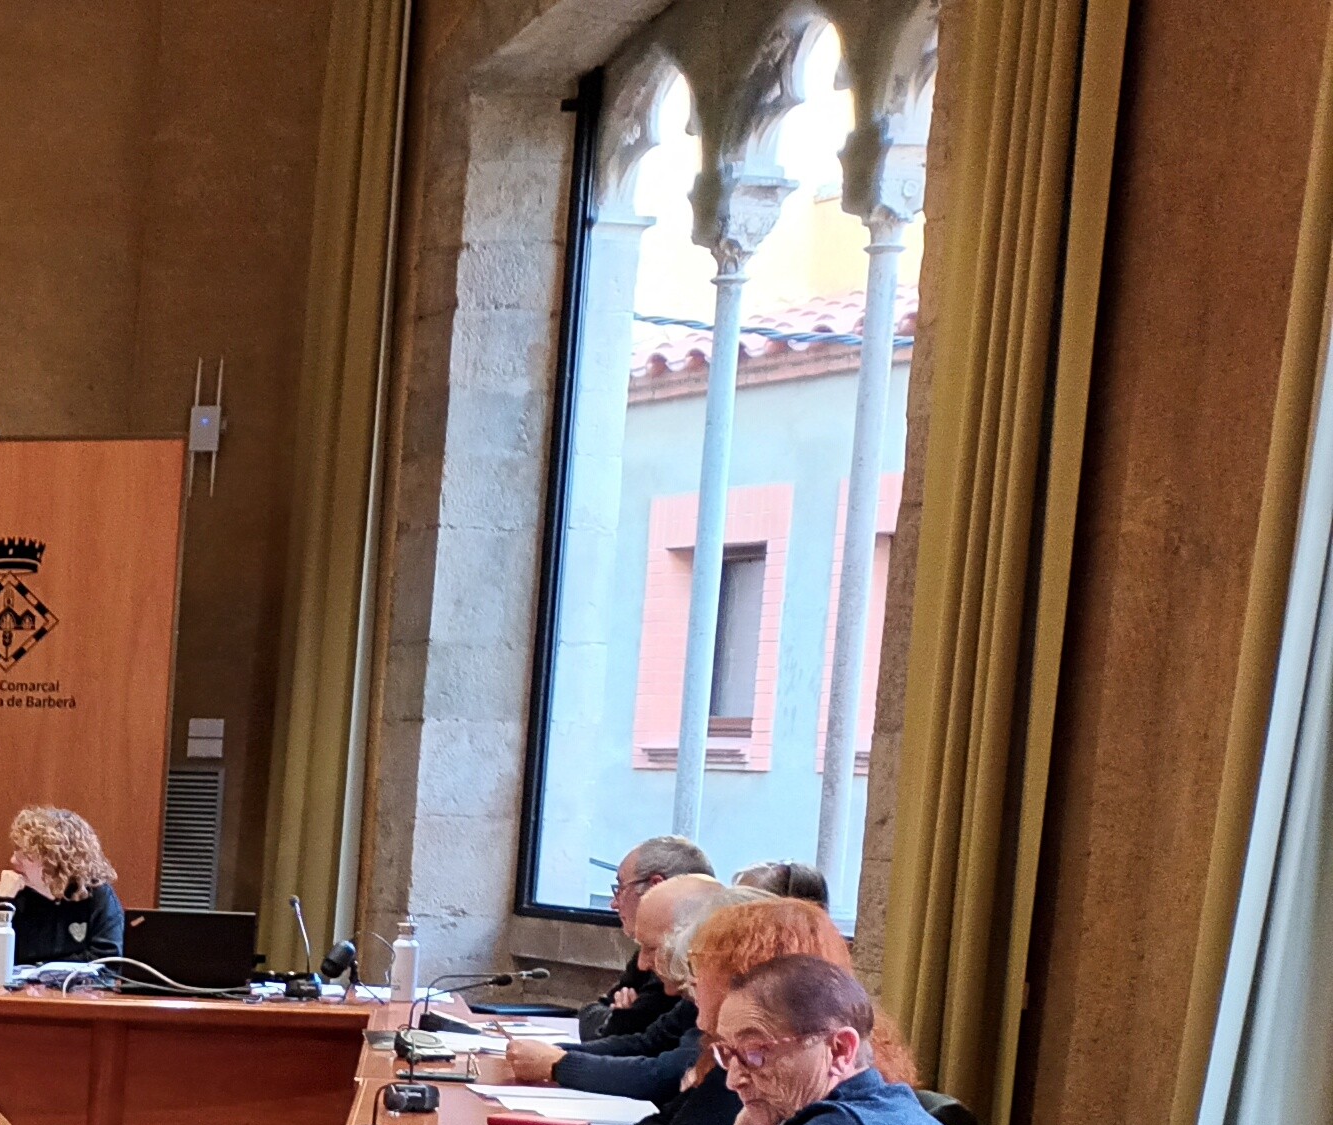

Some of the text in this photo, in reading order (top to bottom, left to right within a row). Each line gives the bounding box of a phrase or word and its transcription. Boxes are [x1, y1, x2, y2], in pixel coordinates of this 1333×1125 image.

[0, 680, 60, 693] Comarcal
[6, 695, 23, 708] de
[26, 695, 77, 709] Barberà
